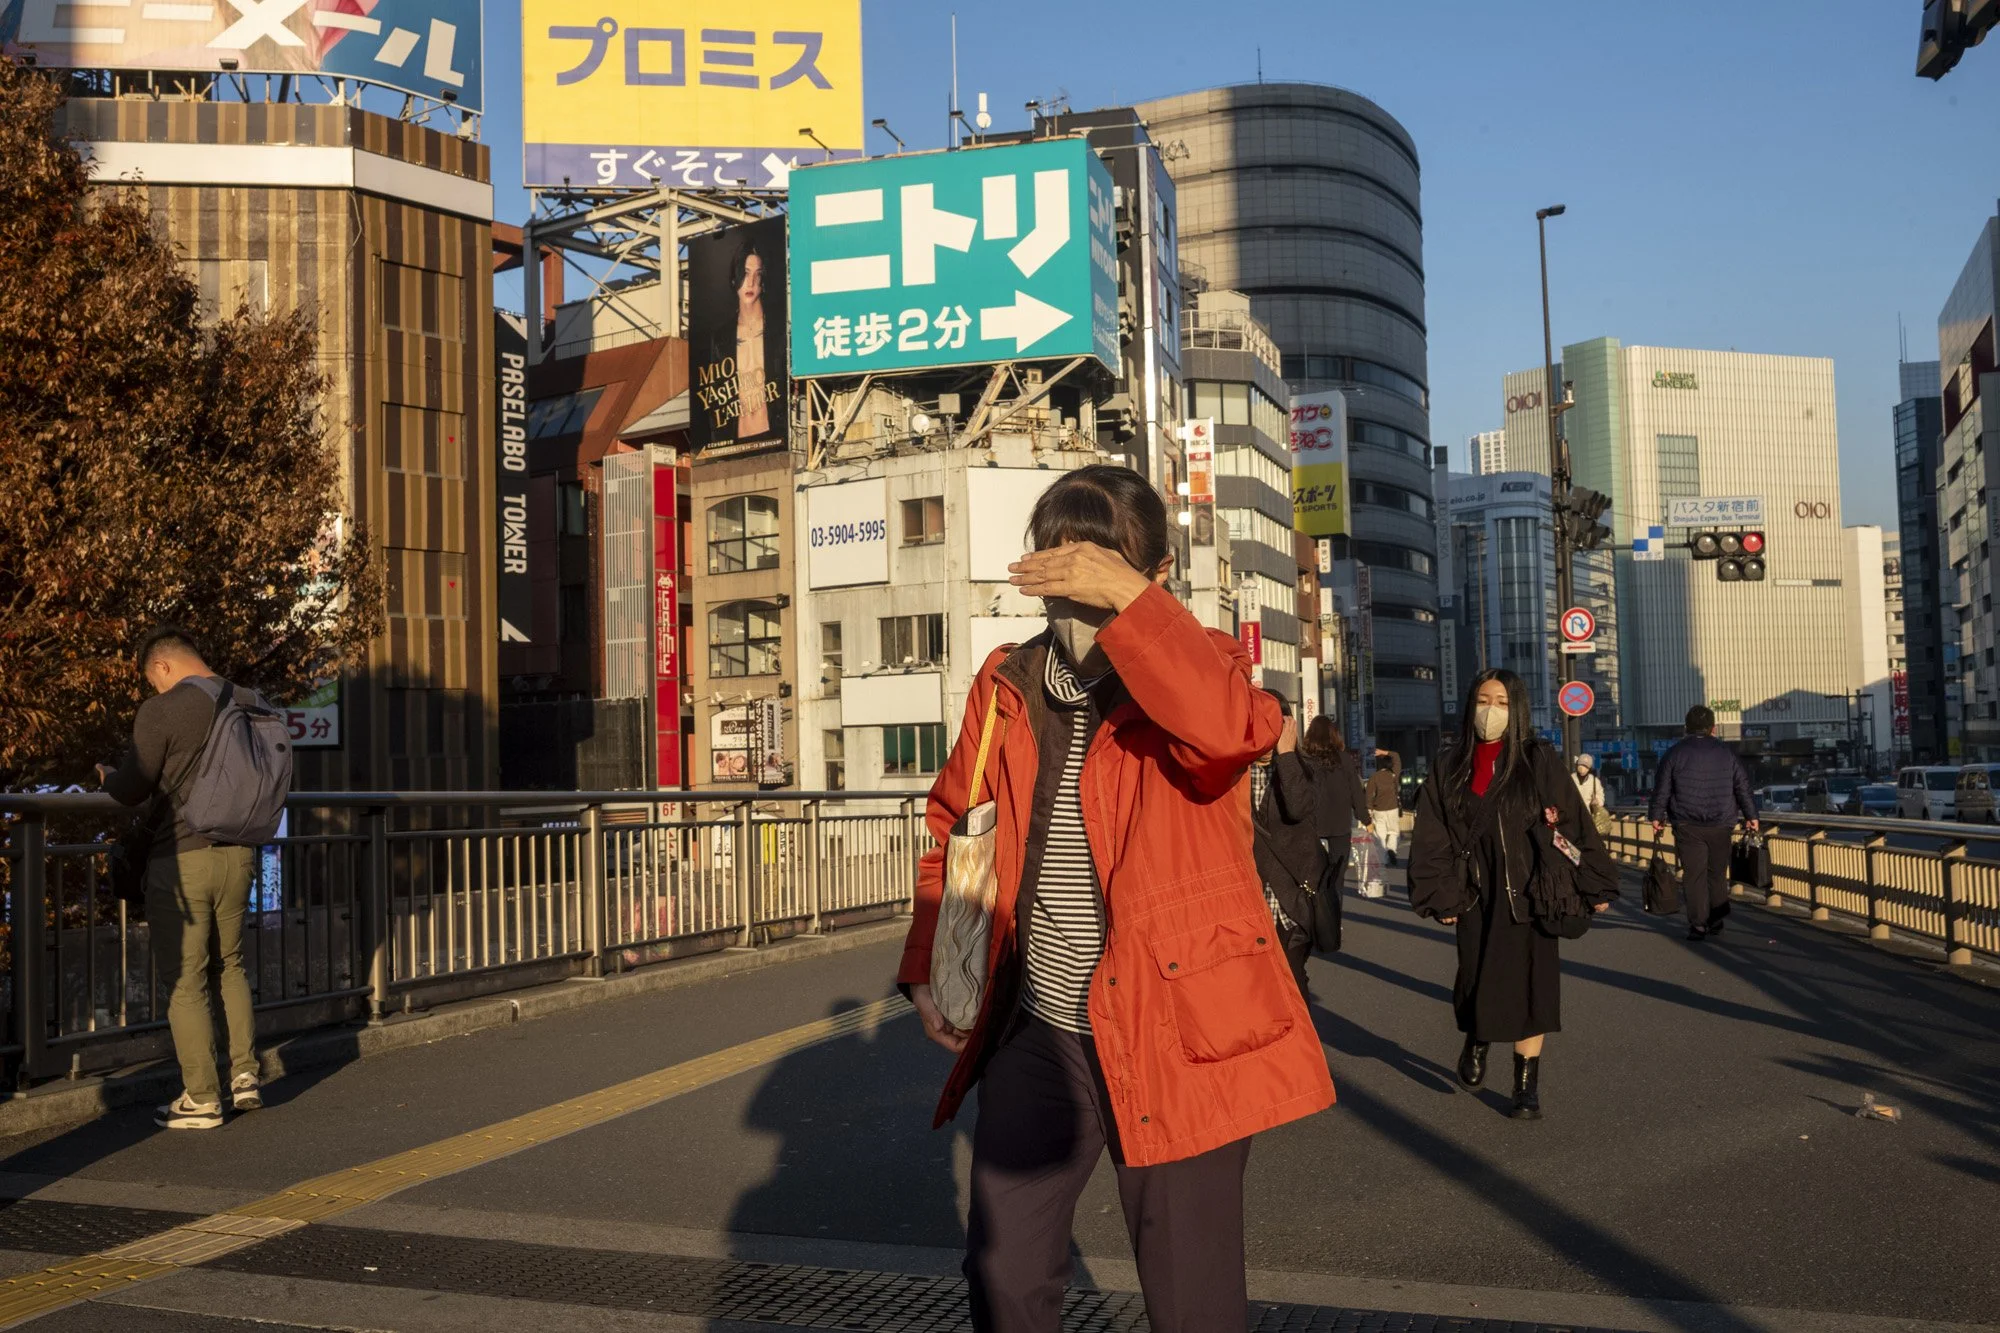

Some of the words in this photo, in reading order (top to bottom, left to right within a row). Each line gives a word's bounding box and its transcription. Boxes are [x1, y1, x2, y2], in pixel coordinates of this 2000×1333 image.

[548, 16, 834, 91] プロミス
[590, 149, 743, 187] すぐそこ
[811, 169, 1071, 295] ニトリ
[813, 304, 973, 360] 徒歩2分
[698, 357, 735, 386] MIO
[501, 352, 526, 472] PASELABO
[1674, 500, 1759, 514] バスタ新宿前
[503, 493, 527, 574] TOWER
[811, 519, 886, 548] 03-5904-5995
[662, 802, 677, 817] 6F
